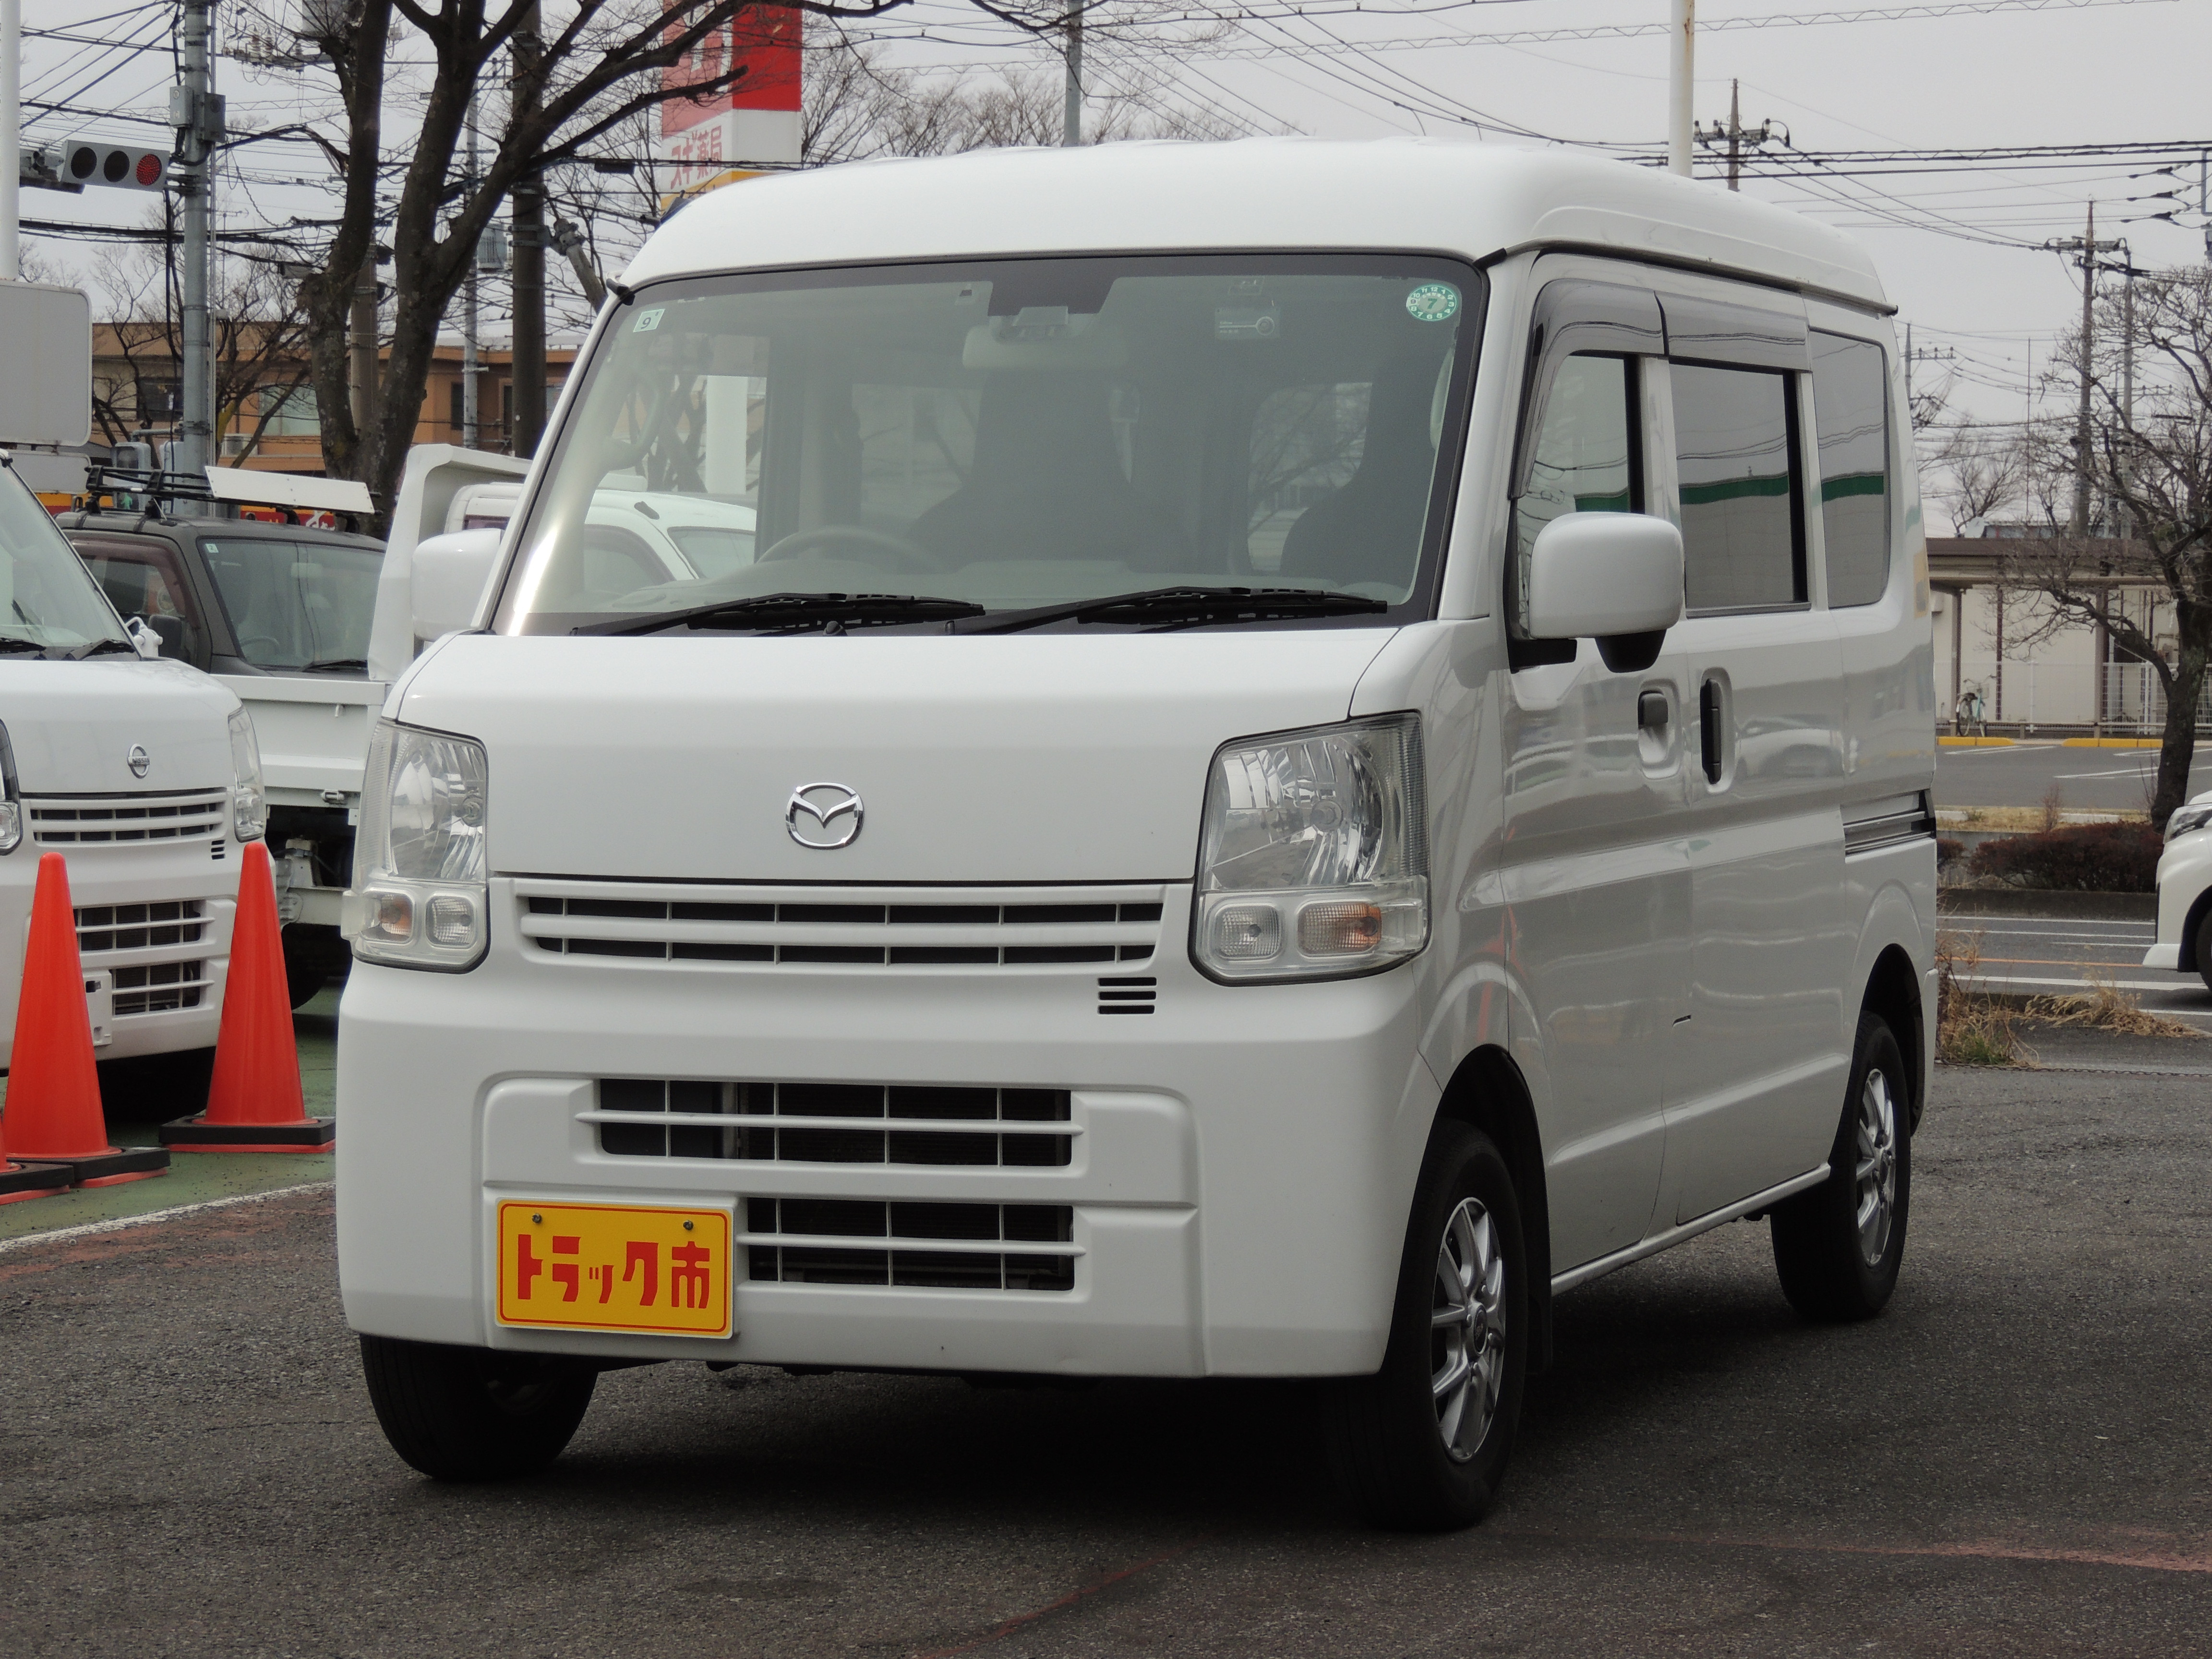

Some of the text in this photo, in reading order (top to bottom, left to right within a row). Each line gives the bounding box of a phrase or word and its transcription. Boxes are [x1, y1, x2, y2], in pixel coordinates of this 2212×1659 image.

[671, 125, 722, 189] スギ薬局
[1428, 298, 1438, 309] 7
[641, 317, 651, 329] 9
[517, 1234, 710, 1309] トラック市
